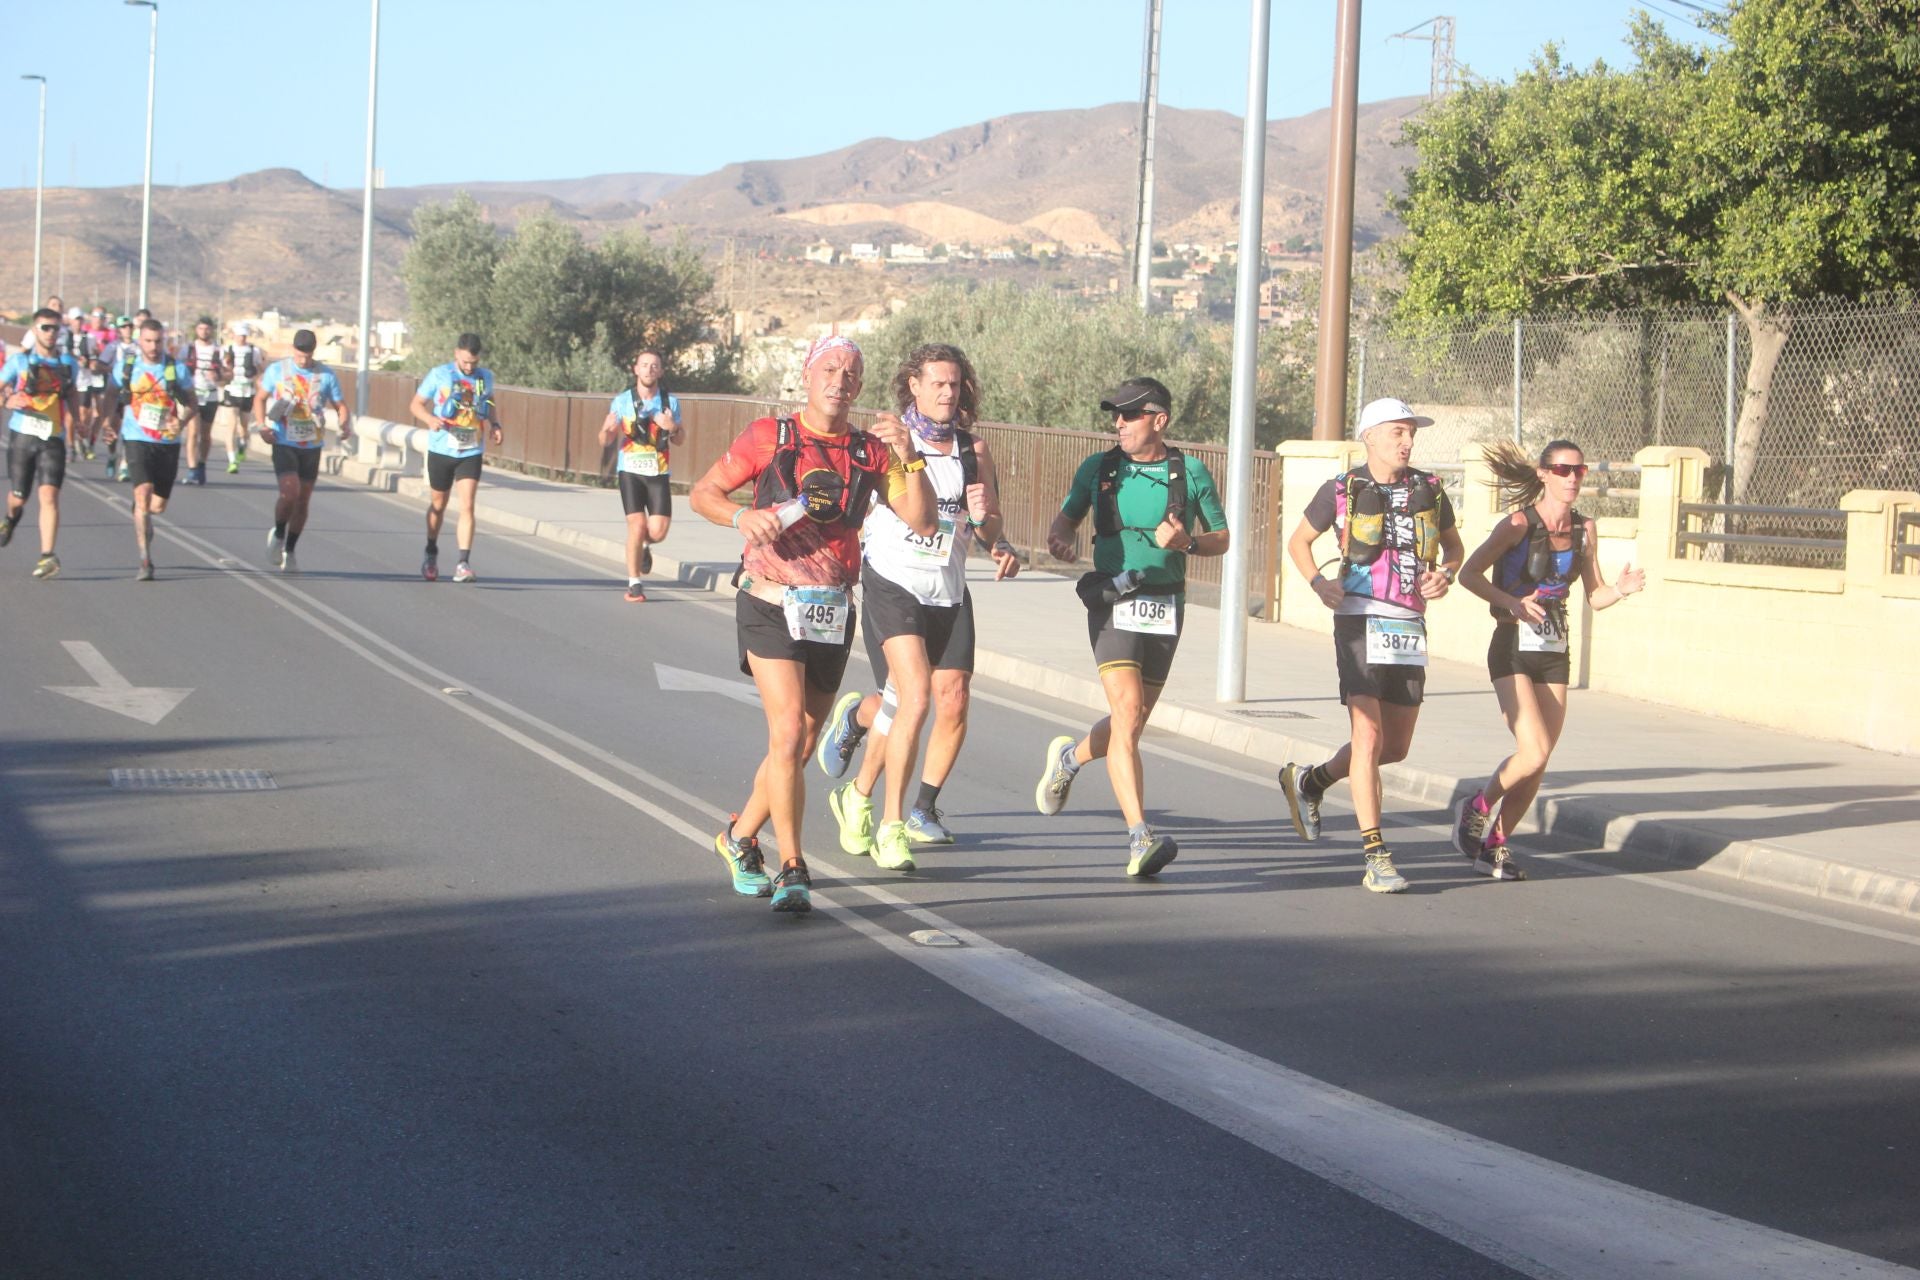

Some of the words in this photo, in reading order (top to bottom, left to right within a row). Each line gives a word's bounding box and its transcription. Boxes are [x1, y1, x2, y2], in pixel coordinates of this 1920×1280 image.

[805, 604, 836, 625] 495
[1129, 600, 1166, 620] 1036
[1382, 633, 1420, 651] 3877
